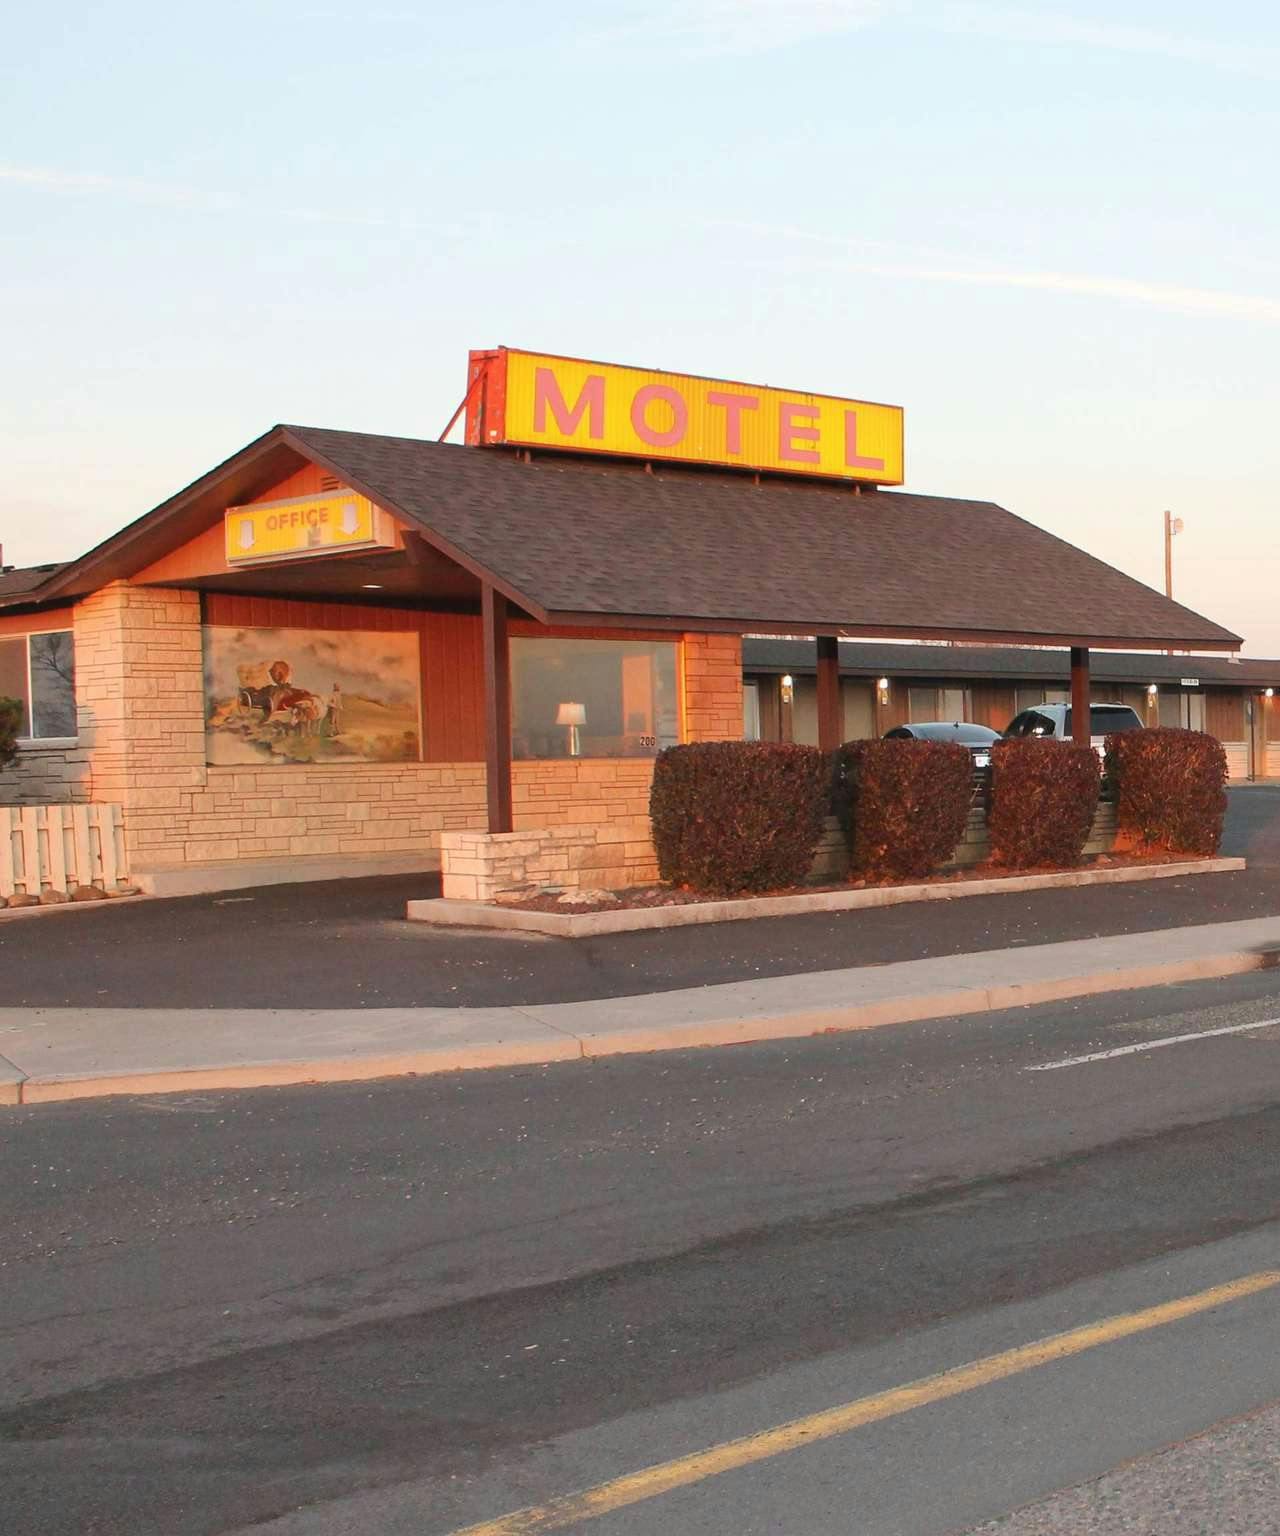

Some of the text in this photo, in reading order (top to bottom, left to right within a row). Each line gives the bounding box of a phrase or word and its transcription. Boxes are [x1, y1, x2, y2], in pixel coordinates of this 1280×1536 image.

[534, 367, 884, 471] MOTEL
[266, 508, 329, 531] OFFICE
[640, 736, 656, 746] 200
